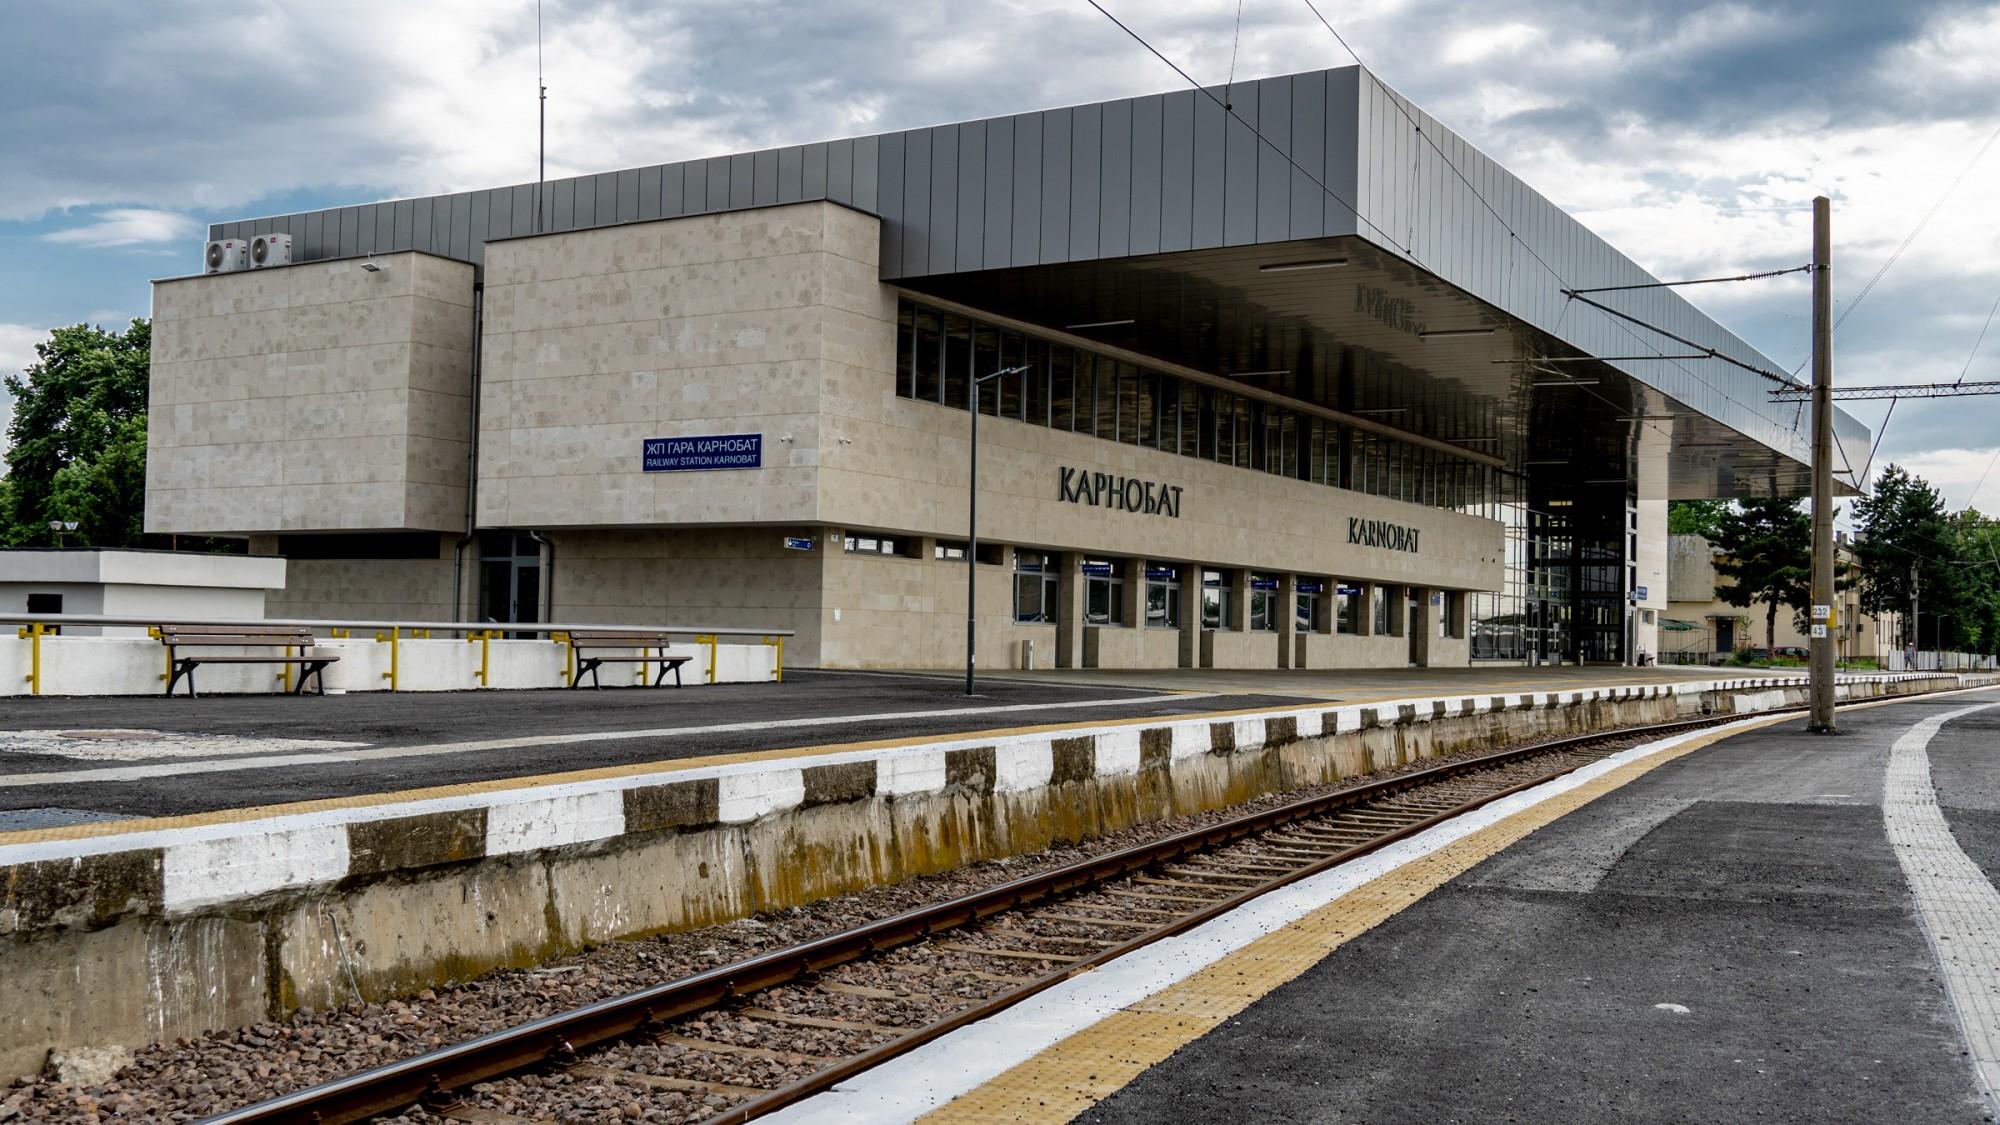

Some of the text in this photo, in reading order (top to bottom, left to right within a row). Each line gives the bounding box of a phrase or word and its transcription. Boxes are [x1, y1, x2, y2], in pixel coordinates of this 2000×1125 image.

[647, 439, 758, 455] ЖП ГАРА КАРНОБАТ
[646, 454, 757, 467] RAILWAY STATION KARNOBAT
[1058, 466, 1183, 518] КАРНОБАТ
[1347, 517, 1420, 553] KARNOBAT
[1812, 607, 1828, 616] 232
